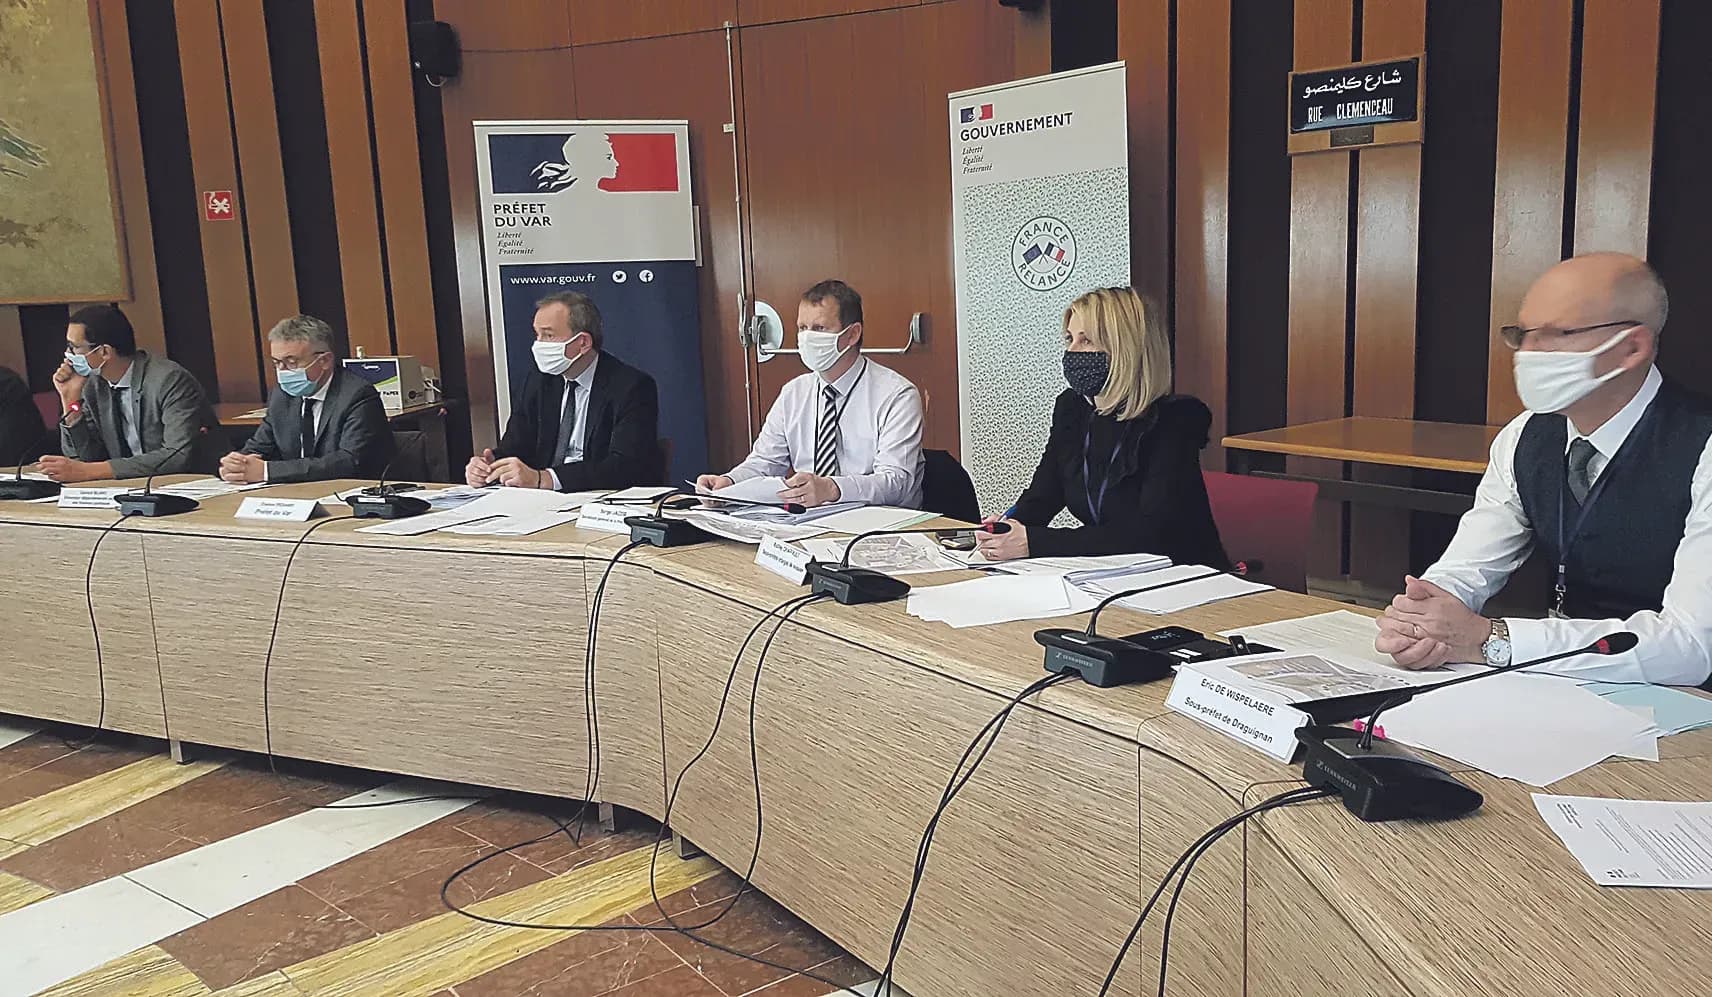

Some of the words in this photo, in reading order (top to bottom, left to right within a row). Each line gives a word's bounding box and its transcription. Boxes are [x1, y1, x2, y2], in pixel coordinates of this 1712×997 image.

[1302, 76, 1362, 98] كليمنصو
[1364, 69, 1402, 92] شارع
[1308, 106, 1324, 123] RUE
[1336, 98, 1394, 120] CLEMENCEAU
[960, 112, 1073, 142] GOUVERNEMENT
[962, 146, 983, 155] Liberté
[962, 155, 984, 165] Égalité
[962, 164, 992, 174] Fraternité
[494, 202, 546, 214] PRÉFET
[495, 217, 516, 227] DU
[520, 216, 552, 226] VAR
[1018, 221, 1070, 246] FRANCE
[498, 248, 534, 256] Fraternité
[510, 273, 596, 285] www.var.gouv.fr
[1018, 260, 1070, 286] RELANCE
[1200, 678, 1214, 691] Eric
[1214, 684, 1226, 695] DE
[1226, 688, 1275, 716] WISPELAERE
[1184, 696, 1222, 720] Sous-préfet
[1222, 713, 1232, 724] de
[1231, 718, 1273, 744] Draguignan
